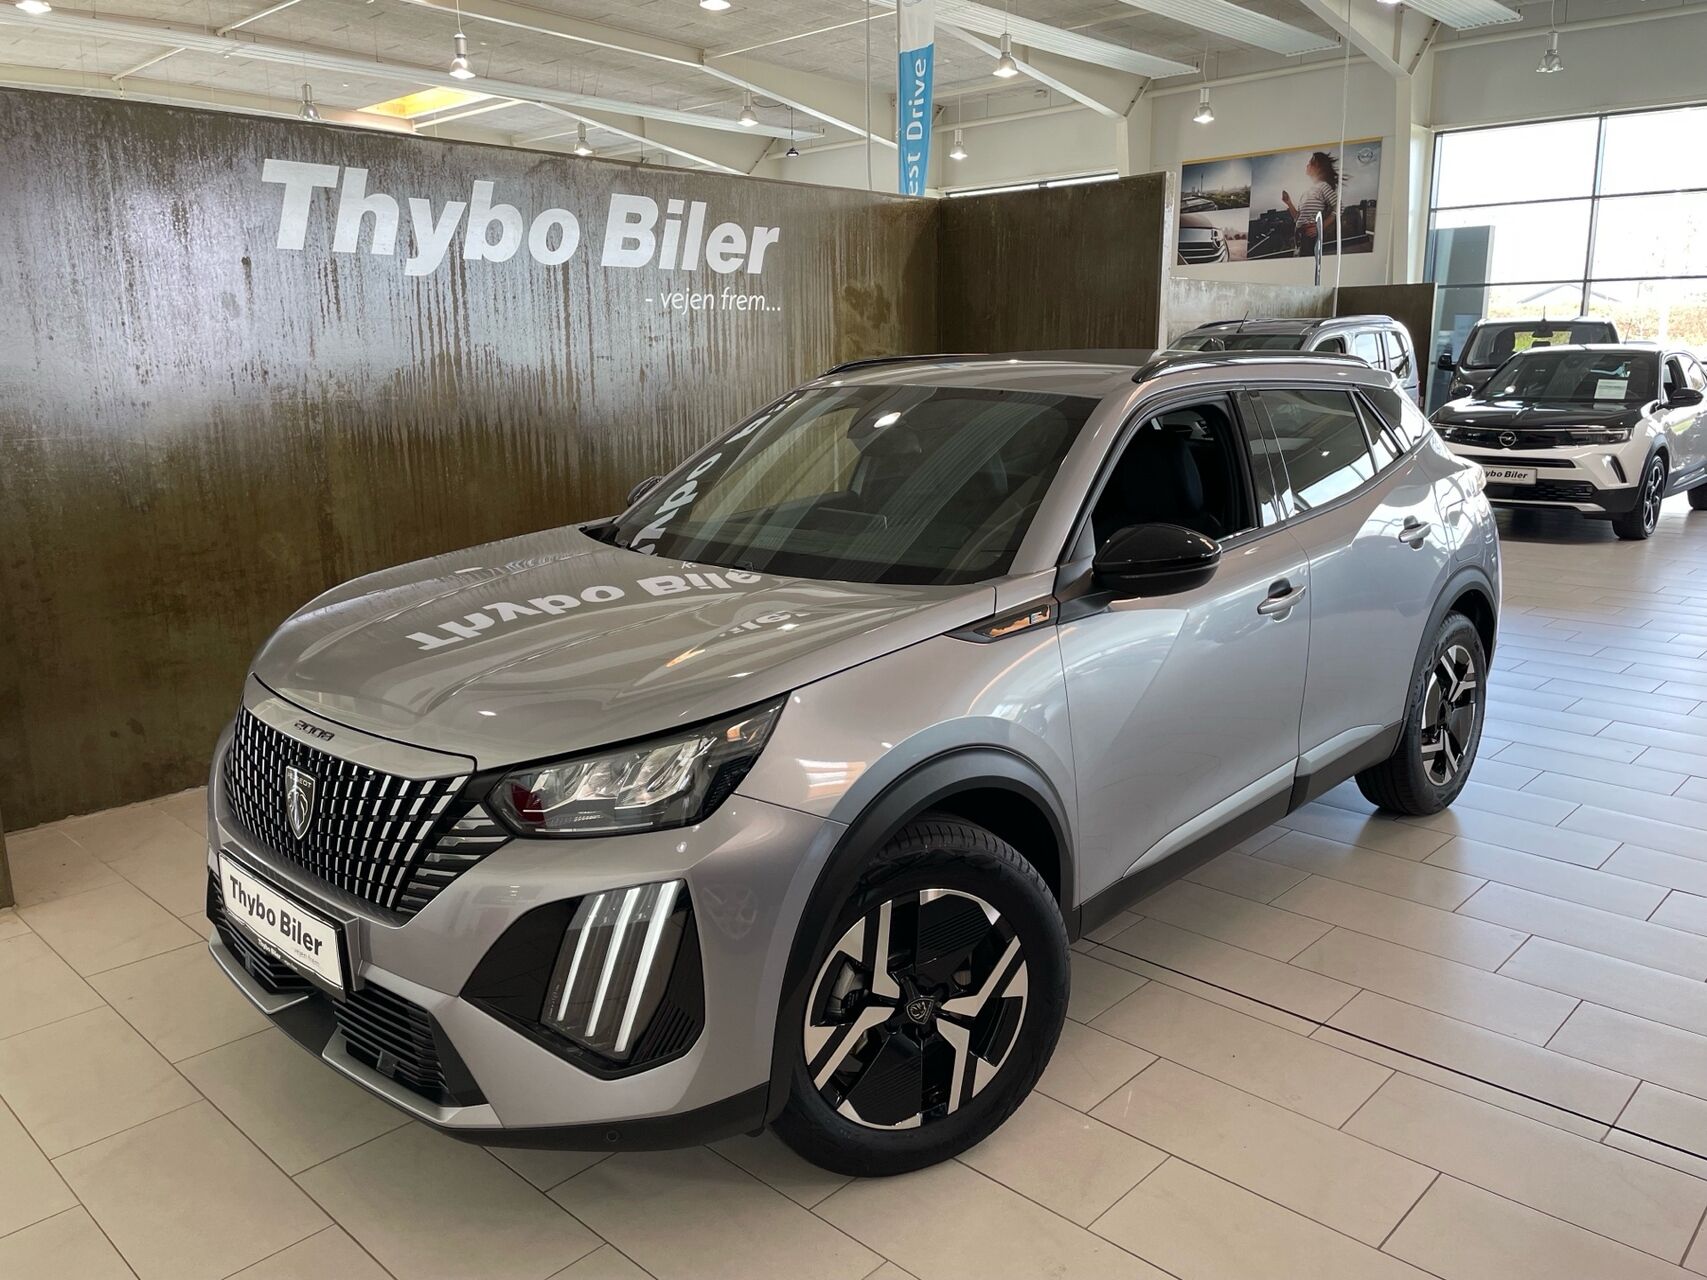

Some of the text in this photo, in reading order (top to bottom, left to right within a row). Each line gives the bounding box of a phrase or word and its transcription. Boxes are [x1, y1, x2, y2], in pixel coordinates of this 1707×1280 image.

[907, 58, 927, 196] est Drive
[261, 158, 780, 276] Thybo Biler
[660, 287, 715, 316] vejen
[721, 286, 781, 312] frem...
[1485, 470, 1528, 479] ybo Biler
[294, 719, 335, 741] 2008
[229, 874, 276, 927] Thybo
[280, 909, 323, 956] Biler
